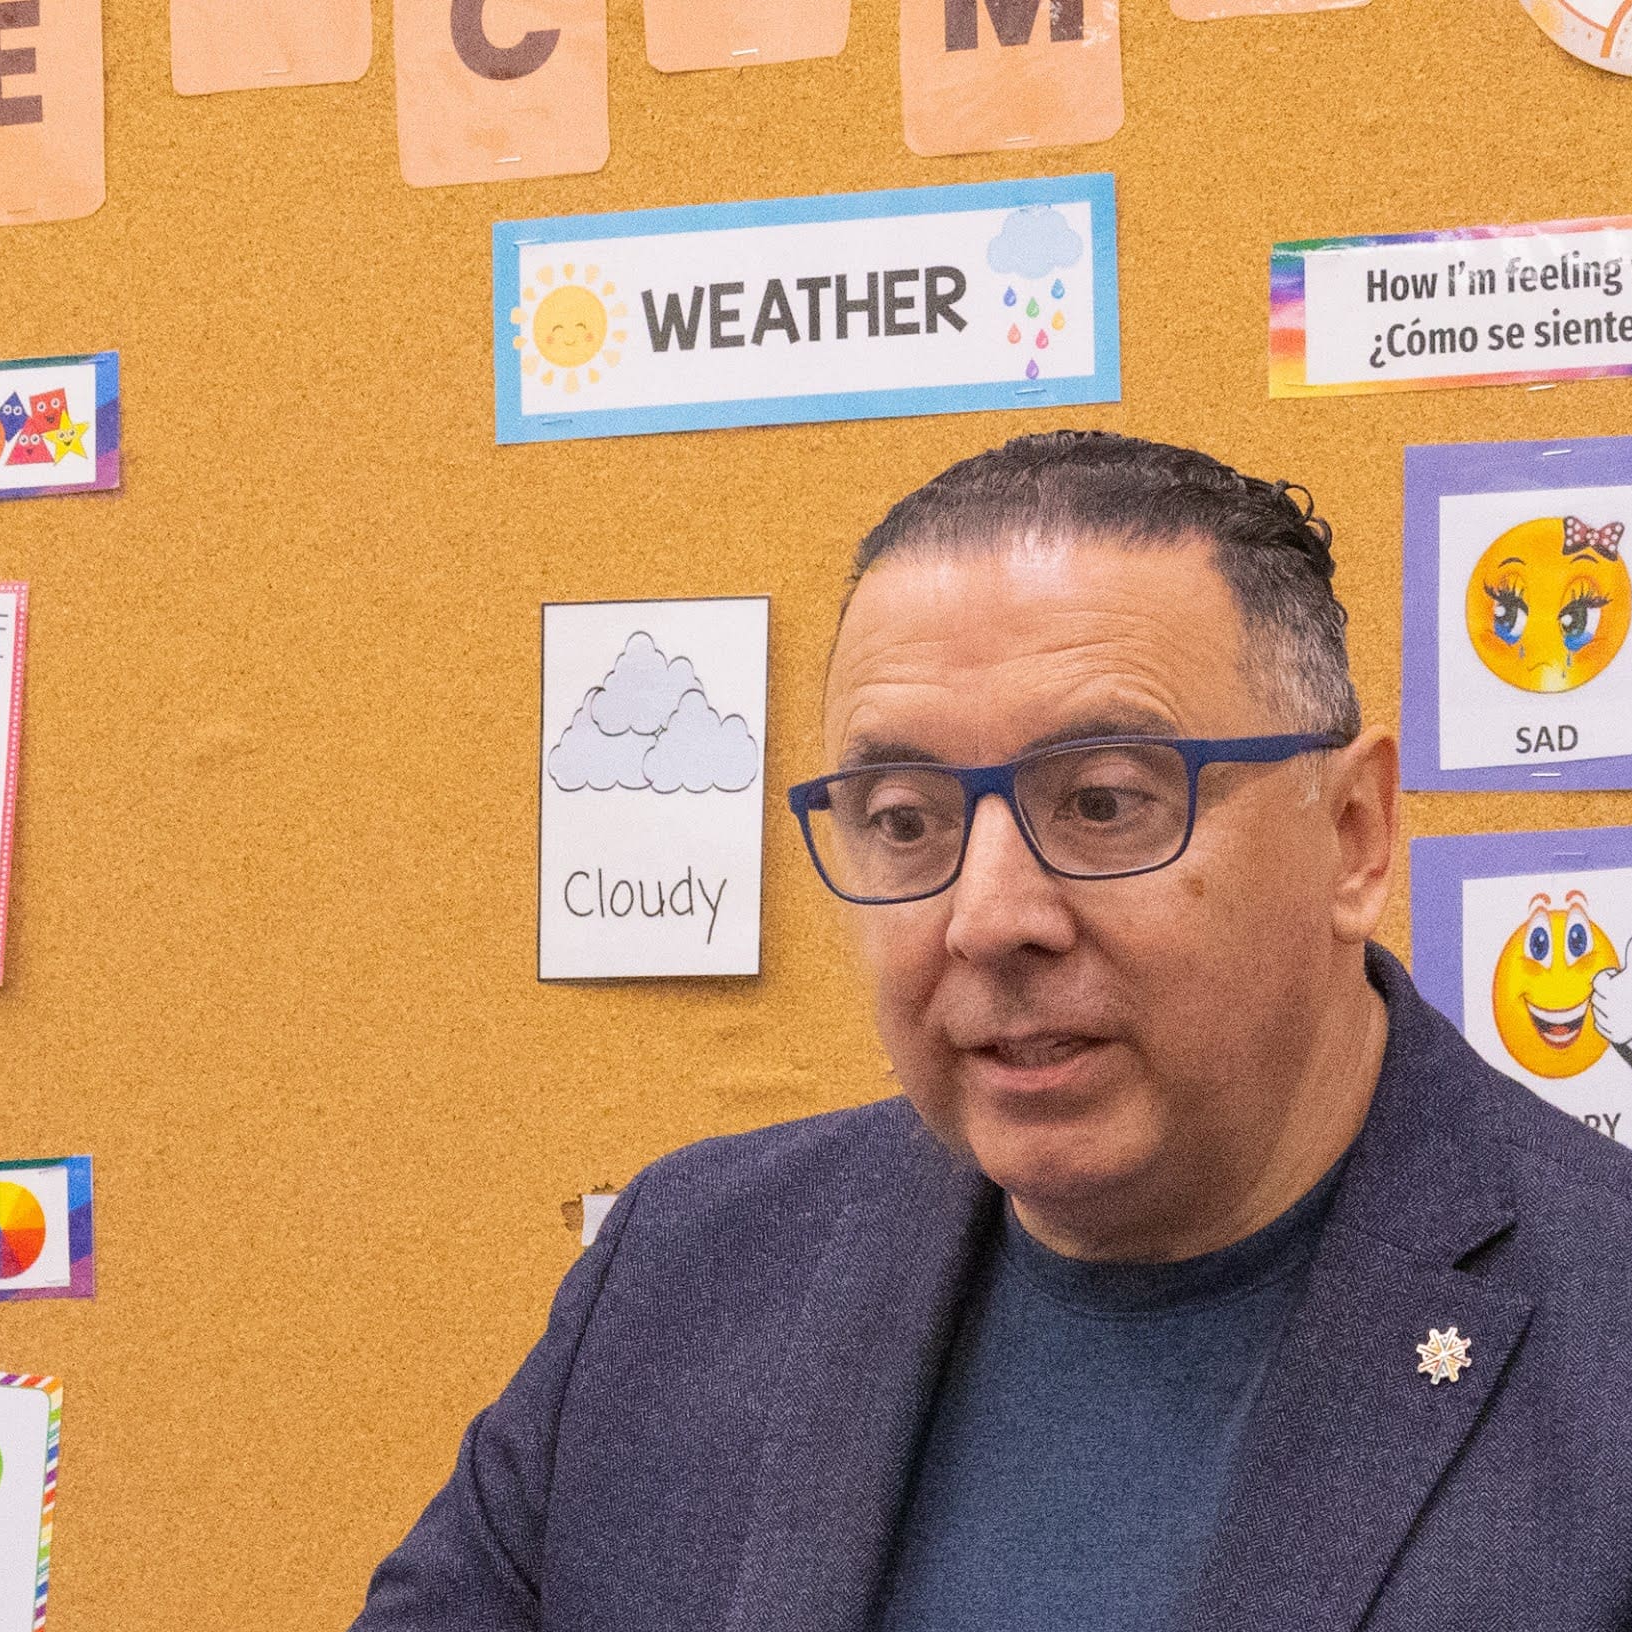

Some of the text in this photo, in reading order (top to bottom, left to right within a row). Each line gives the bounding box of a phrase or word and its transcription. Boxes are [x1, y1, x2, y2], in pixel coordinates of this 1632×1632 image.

[1366, 266, 1438, 304] How
[1447, 262, 1495, 297] I'm
[1504, 254, 1623, 299] feeling
[640, 264, 967, 353] WEATHER
[1367, 320, 1479, 369] ¿Cómo
[1487, 320, 1524, 351] se
[1515, 725, 1579, 754] SAD
[565, 866, 727, 944] Cloudy
